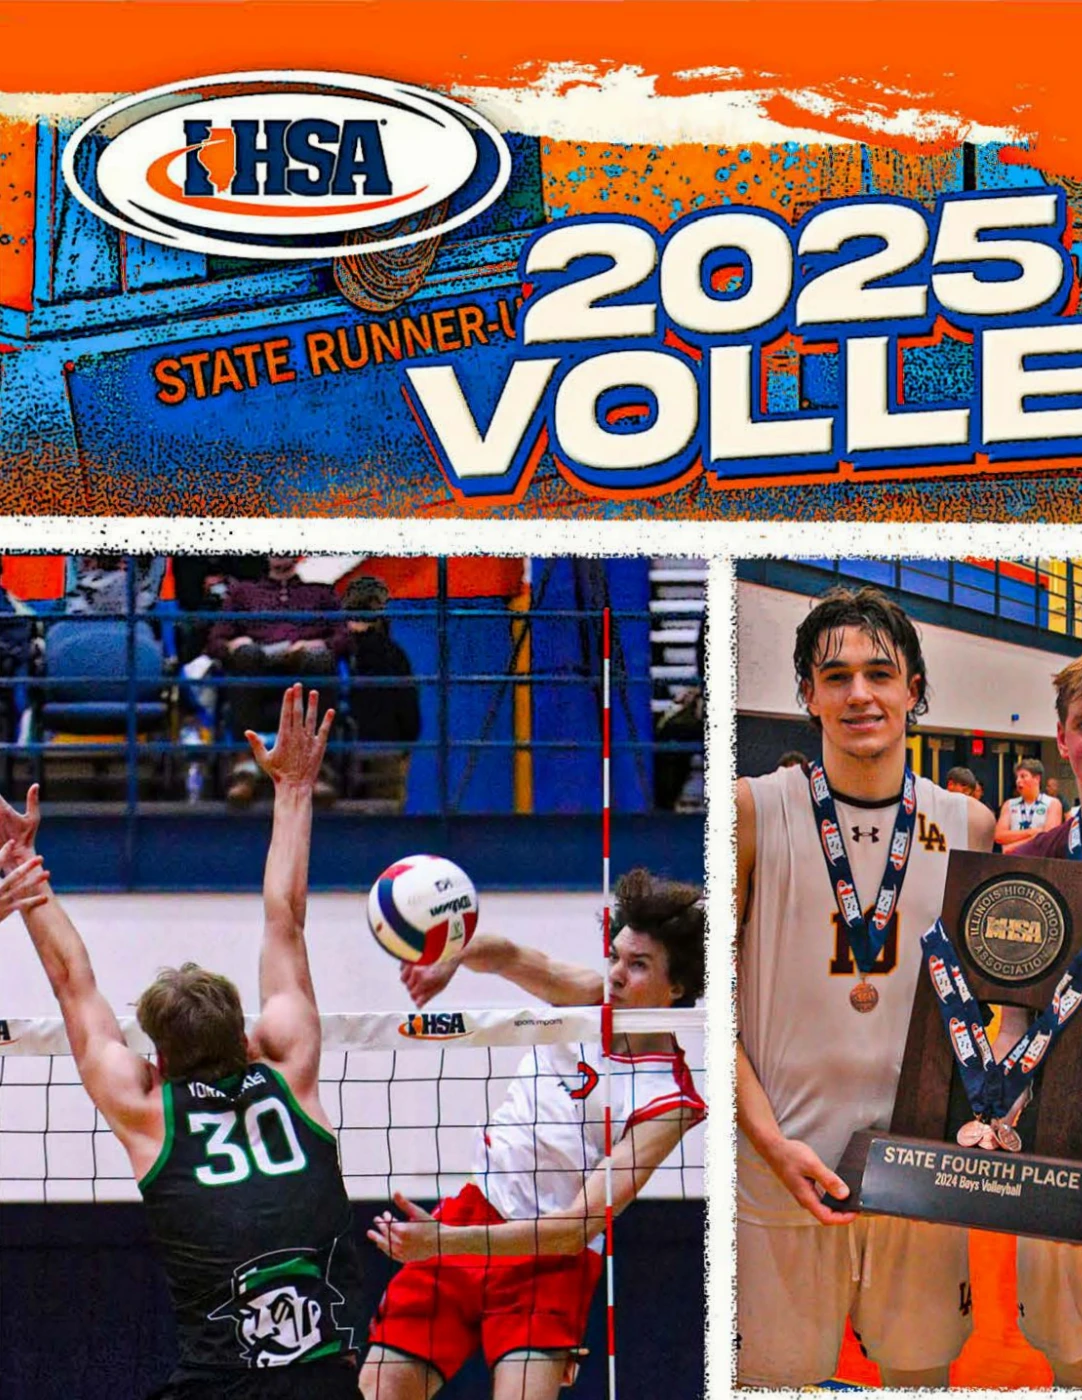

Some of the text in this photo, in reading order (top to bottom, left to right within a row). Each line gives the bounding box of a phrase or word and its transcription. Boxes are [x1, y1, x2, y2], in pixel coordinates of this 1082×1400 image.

[184, 119, 393, 196] IHSA
[523, 193, 1064, 345] 2025
[154, 339, 296, 405] STATE
[970, 886, 1059, 975] ILLINOIS HIGH SCHOOL ASSOCIATION
[408, 1012, 467, 1035] IHSA
[187, 1096, 307, 1186] 30
[884, 1146, 1081, 1190] STATE FOURTH PLACE
[935, 1172, 1022, 1197] 2024 Boys Volleyball
